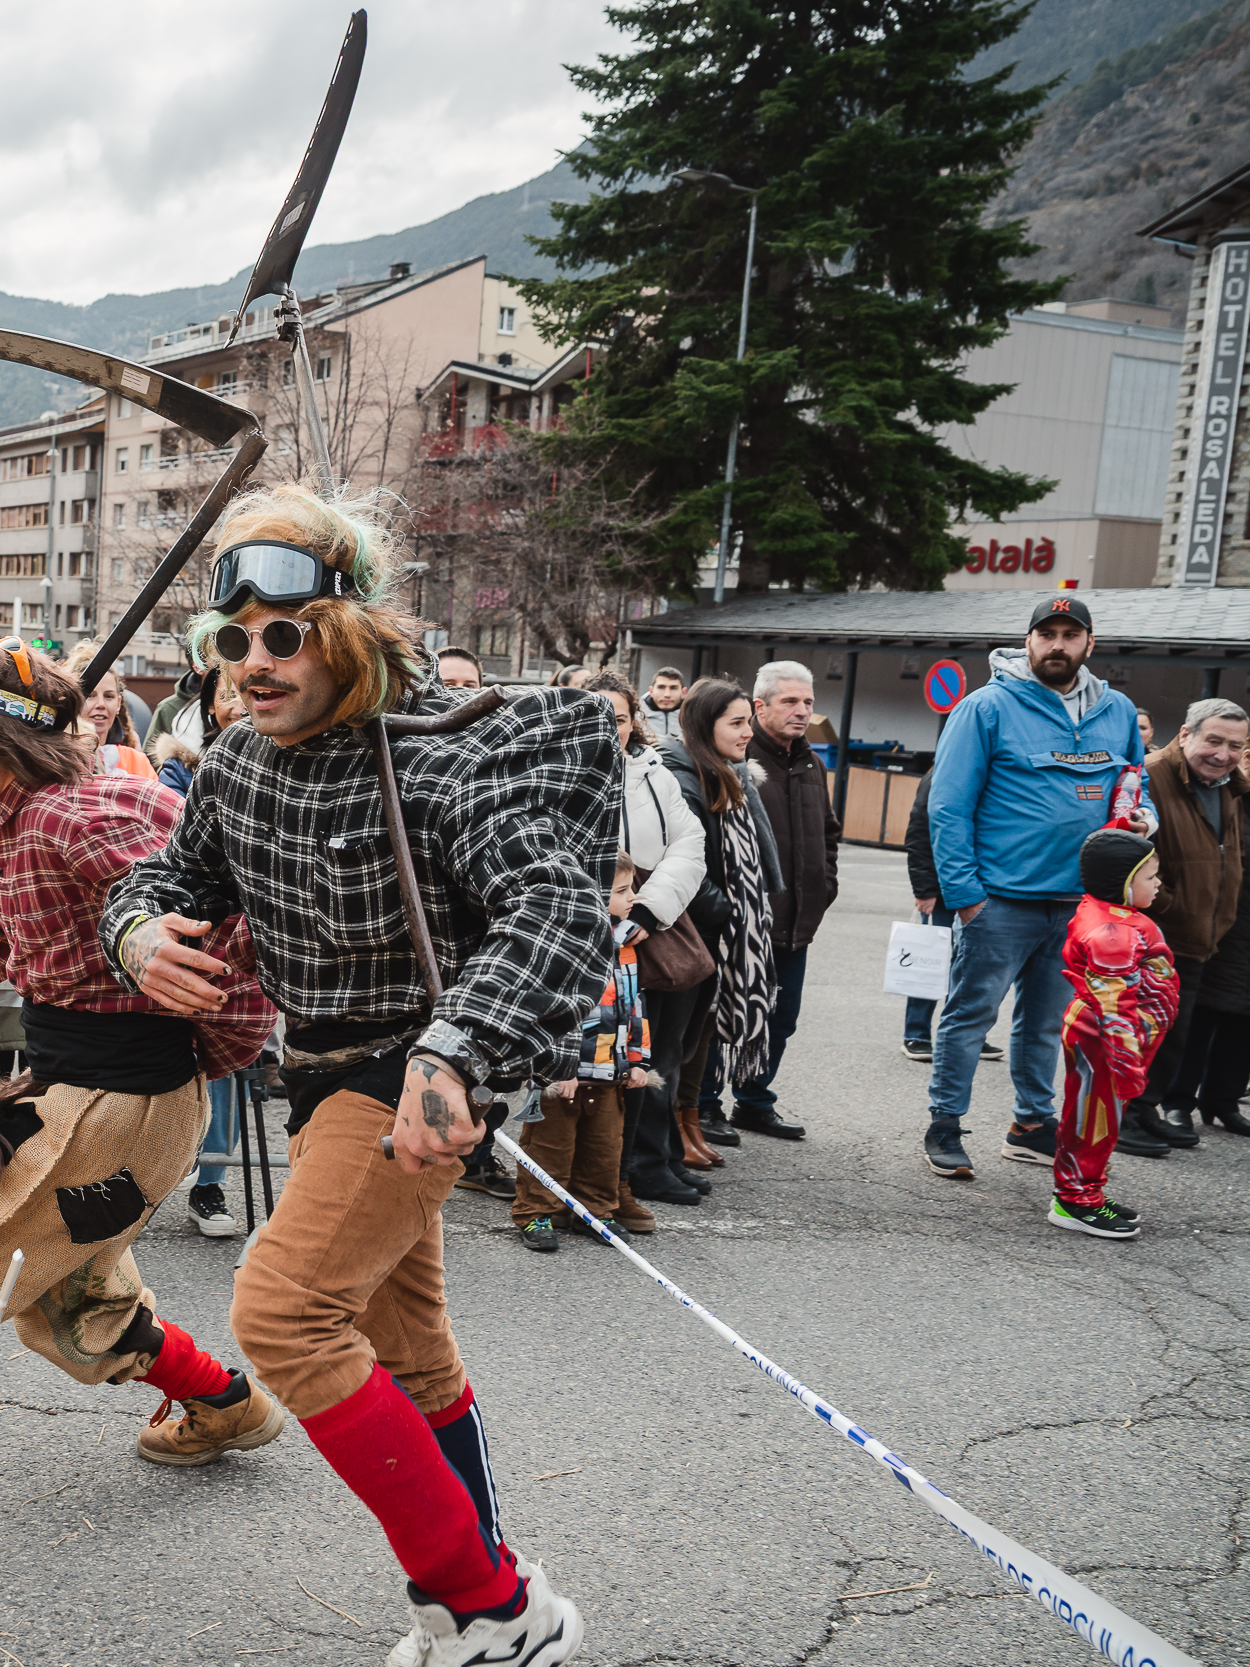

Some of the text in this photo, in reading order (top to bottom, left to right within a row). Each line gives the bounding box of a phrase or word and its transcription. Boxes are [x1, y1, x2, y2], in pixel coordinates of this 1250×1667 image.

[1190, 250, 1249, 564] HOTEL ROSALEDA
[949, 536, 1055, 573] atalà
